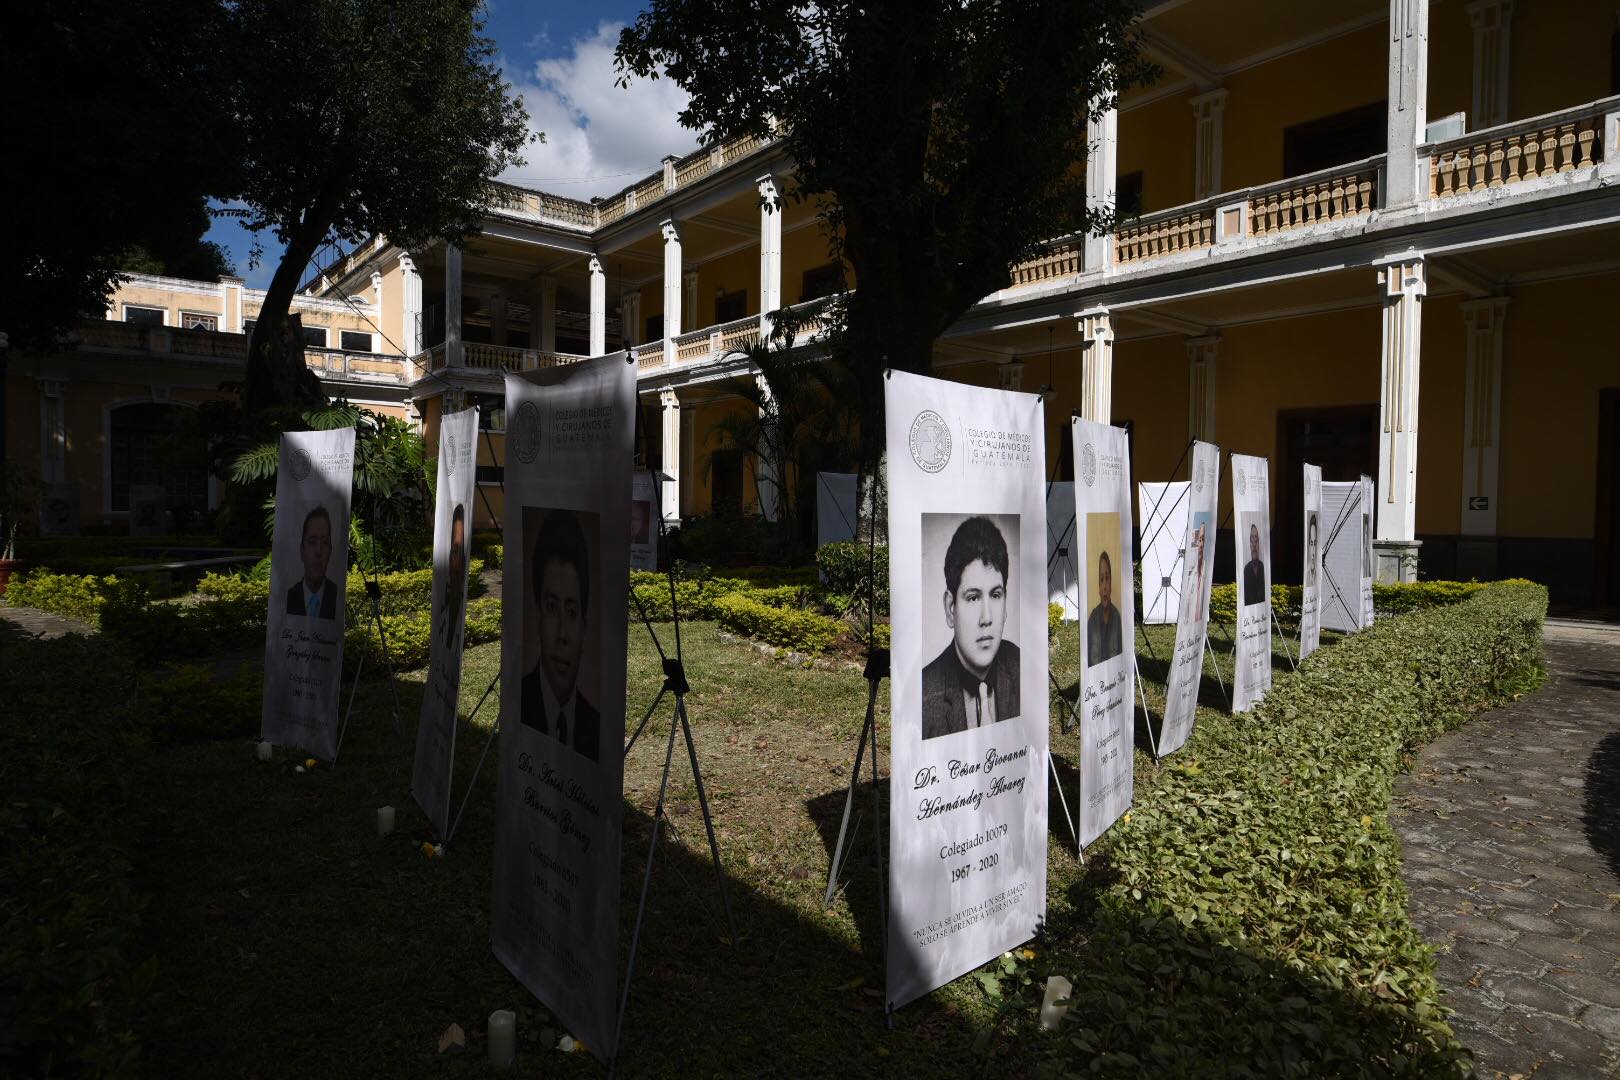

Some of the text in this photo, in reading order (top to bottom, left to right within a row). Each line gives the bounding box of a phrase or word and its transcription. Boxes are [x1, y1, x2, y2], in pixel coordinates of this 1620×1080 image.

[968, 428, 996, 439] COLEGIO
[998, 431, 1006, 440] DE
[978, 440, 1021, 452] CIRUJANOS
[1022, 444, 1031, 453] DE
[973, 450, 1031, 462] GUATEMALA
[914, 745, 1027, 790] Dr. César Giovanni
[917, 776, 1026, 820] Hernández Alvarez
[940, 824, 1008, 859] Colegiado 10079
[952, 864, 971, 883] 1967
[979, 853, 999, 872] 2020
[952, 907, 977, 922] OLVIDA
[984, 899, 994, 908] UN
[994, 892, 1006, 902] SER
[950, 916, 978, 933] APRENDE
